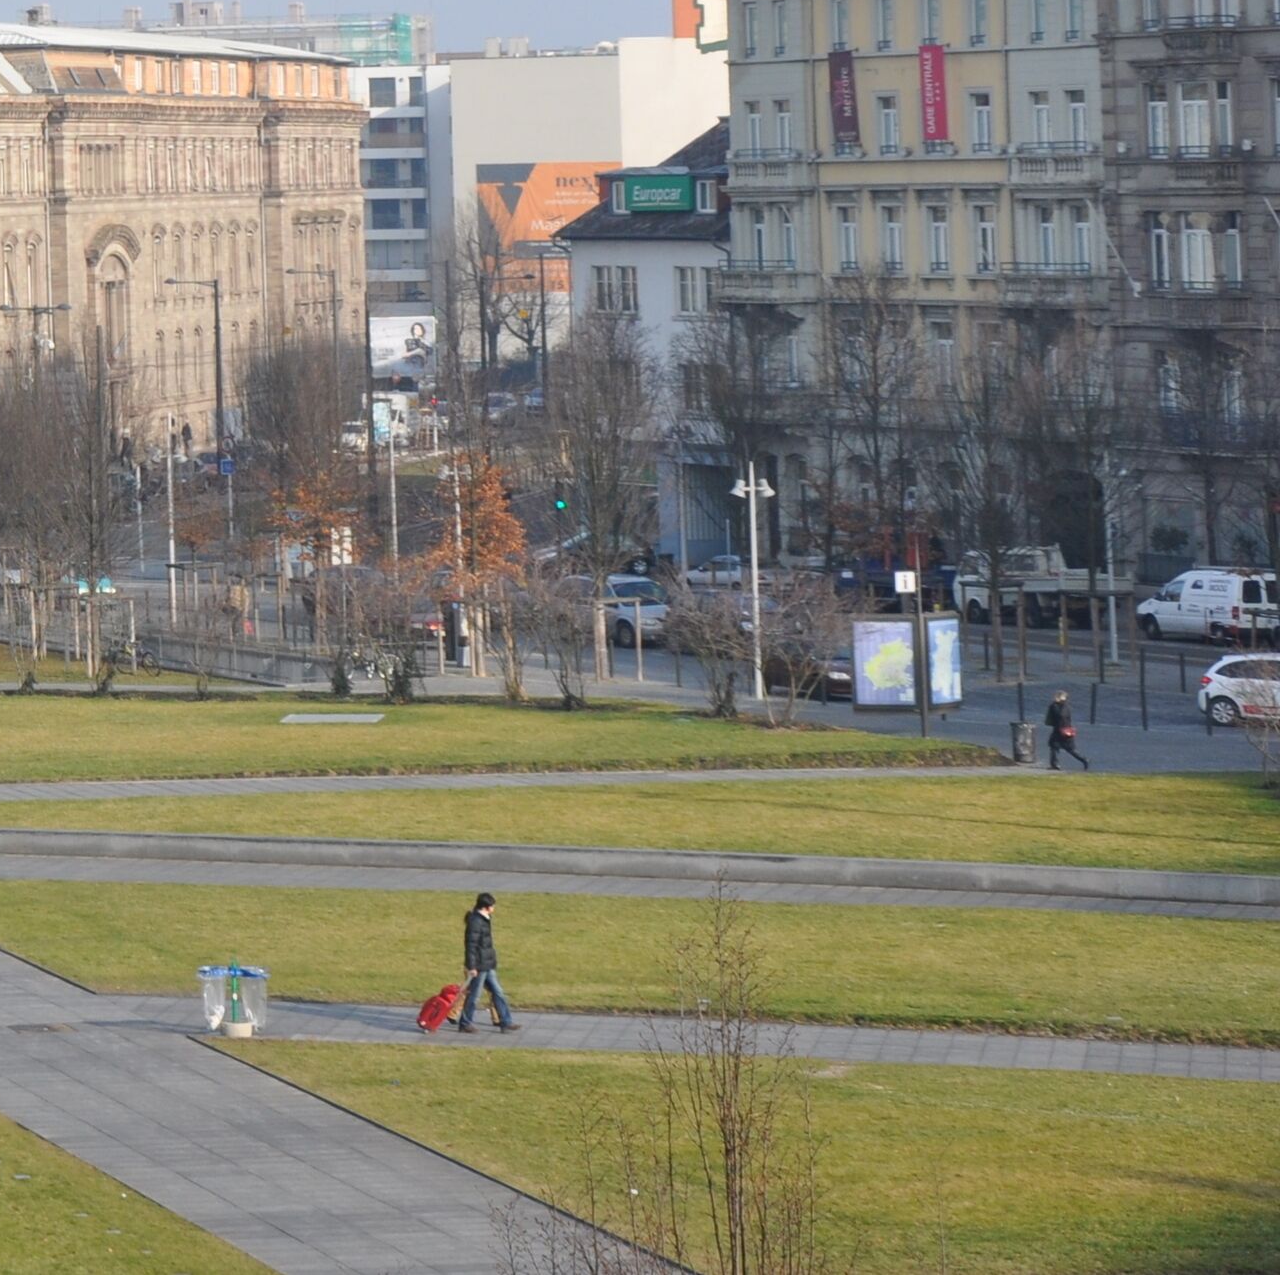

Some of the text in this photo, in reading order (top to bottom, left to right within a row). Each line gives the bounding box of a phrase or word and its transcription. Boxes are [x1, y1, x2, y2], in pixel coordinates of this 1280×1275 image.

[841, 66, 853, 117] Mercure
[923, 52, 936, 134] GARE CENTRALE
[632, 185, 682, 203] Europcar
